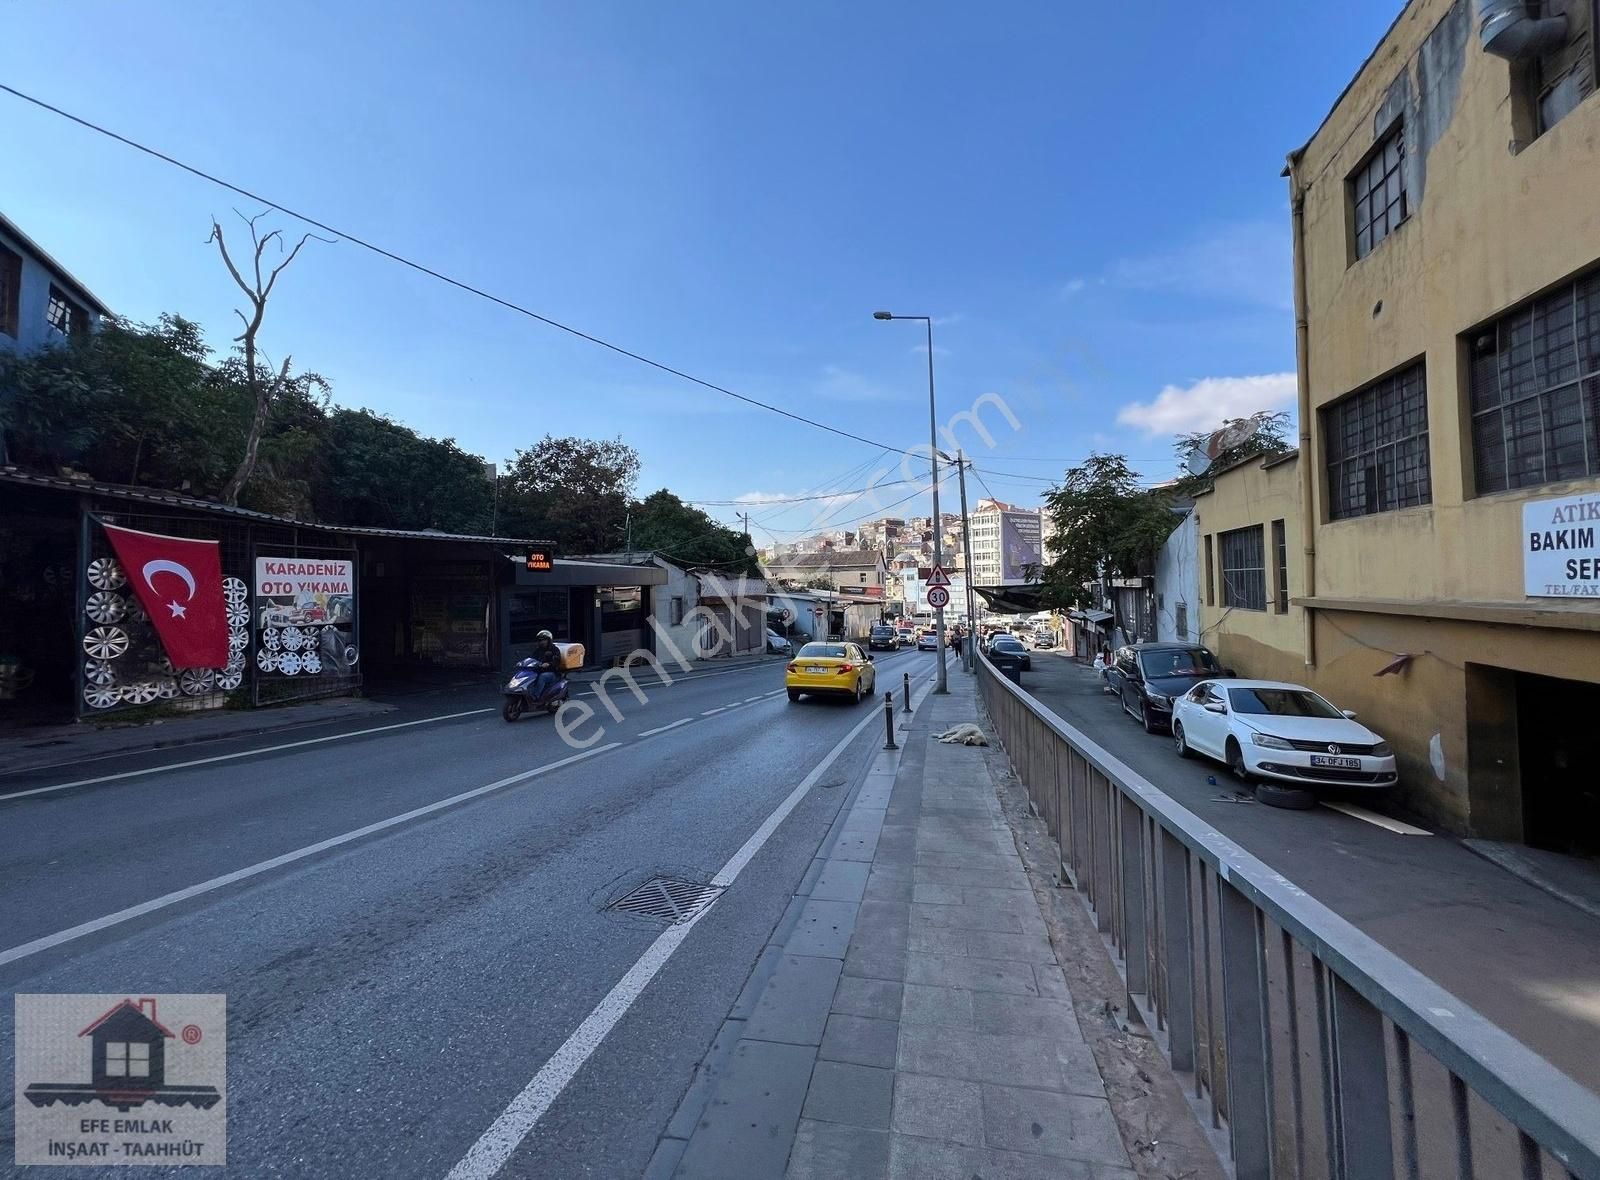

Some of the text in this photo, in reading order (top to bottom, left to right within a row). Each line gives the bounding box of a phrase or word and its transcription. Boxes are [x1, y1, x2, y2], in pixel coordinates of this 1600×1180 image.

[1530, 528, 1594, 552] BAKIM
[265, 562, 346, 576] KARADENİZ
[262, 582, 293, 594] OTO
[931, 592, 946, 603] 30
[1316, 756, 1326, 765] 34
